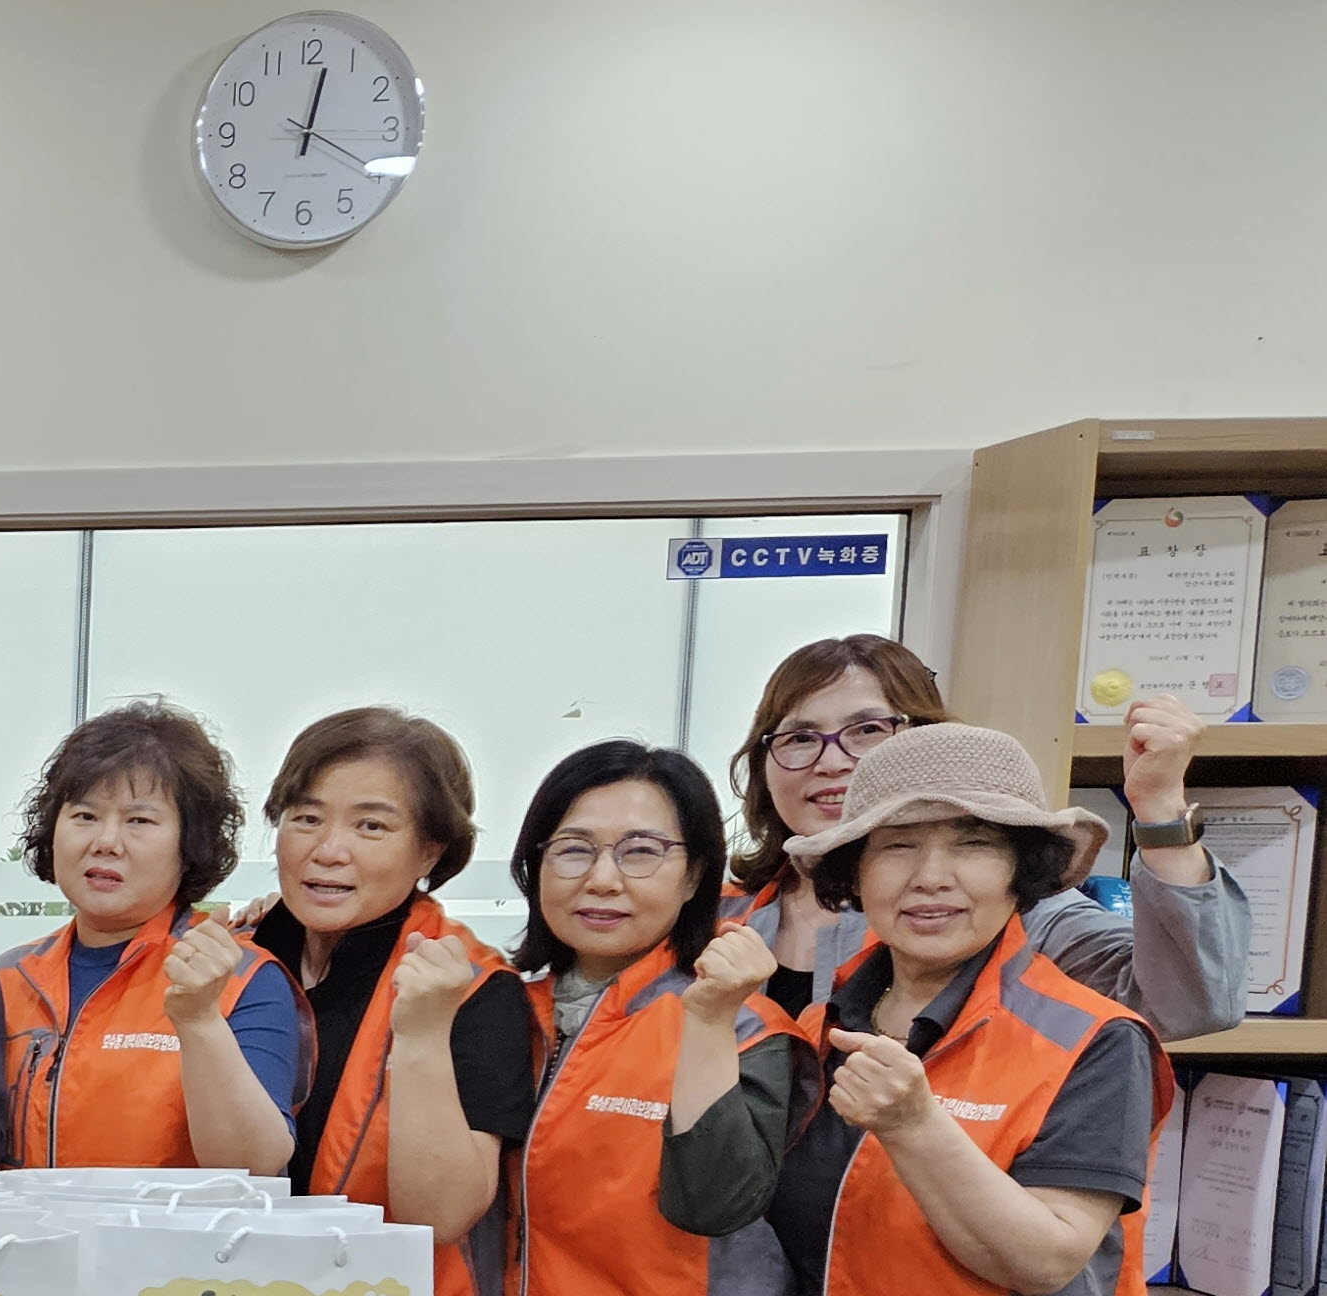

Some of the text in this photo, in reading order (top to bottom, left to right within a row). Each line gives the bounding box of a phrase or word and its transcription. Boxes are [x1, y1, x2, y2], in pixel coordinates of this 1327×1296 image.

[263, 50, 282, 76] 11
[300, 38, 324, 65] 12
[232, 80, 256, 107] 10
[372, 75, 390, 102] 2
[218, 121, 236, 148] 9
[381, 116, 400, 143] 3
[228, 162, 247, 189] 8
[258, 191, 276, 217] 7
[295, 200, 313, 226] 6
[336, 188, 354, 214] 5
[681, 551, 709, 566] ADT
